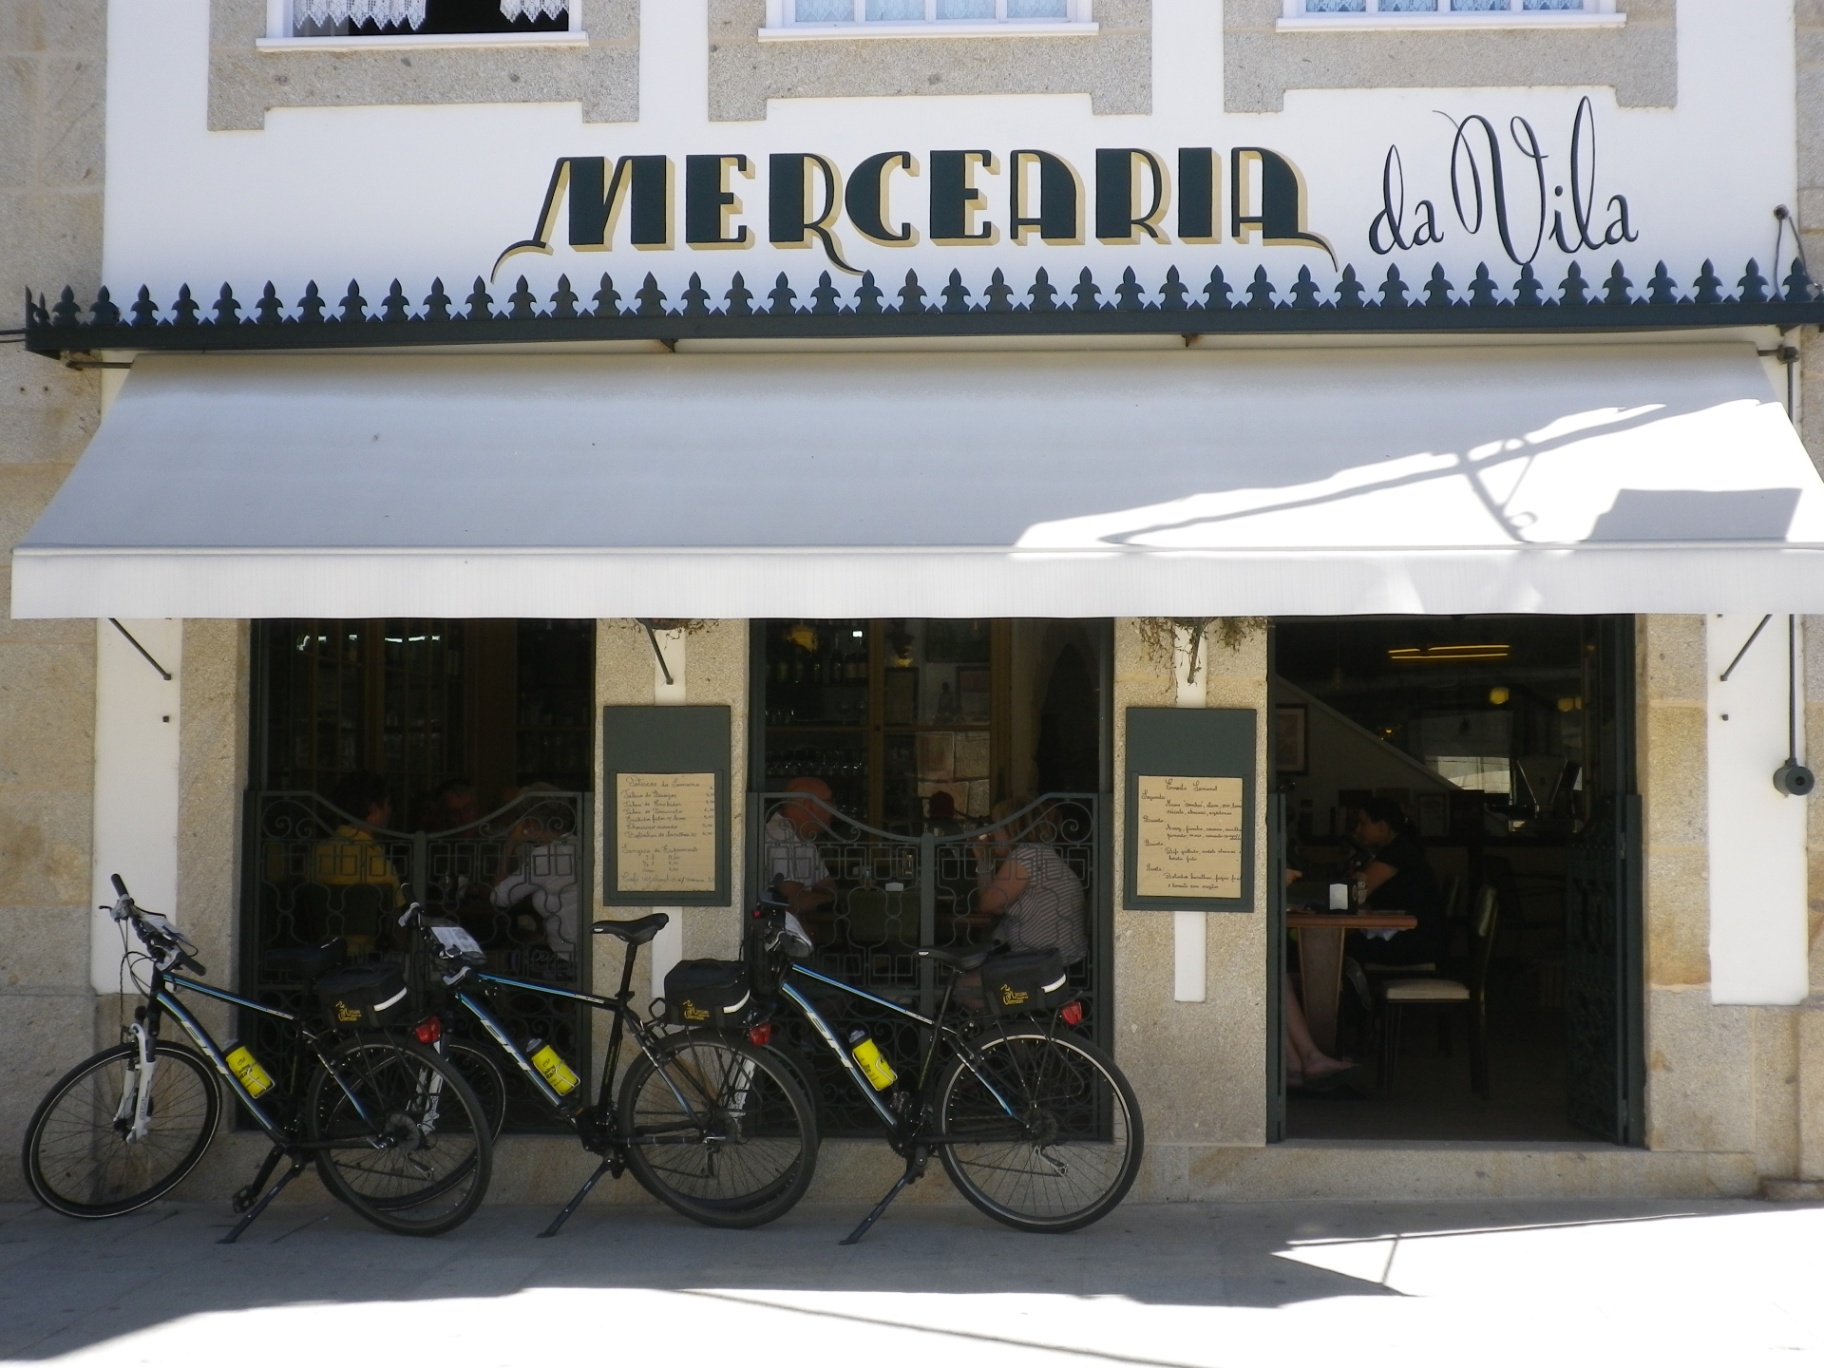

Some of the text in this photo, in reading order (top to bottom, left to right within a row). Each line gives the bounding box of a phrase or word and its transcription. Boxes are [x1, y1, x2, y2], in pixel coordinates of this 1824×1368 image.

[491, 95, 1639, 279] MERCEARIA da Vila
